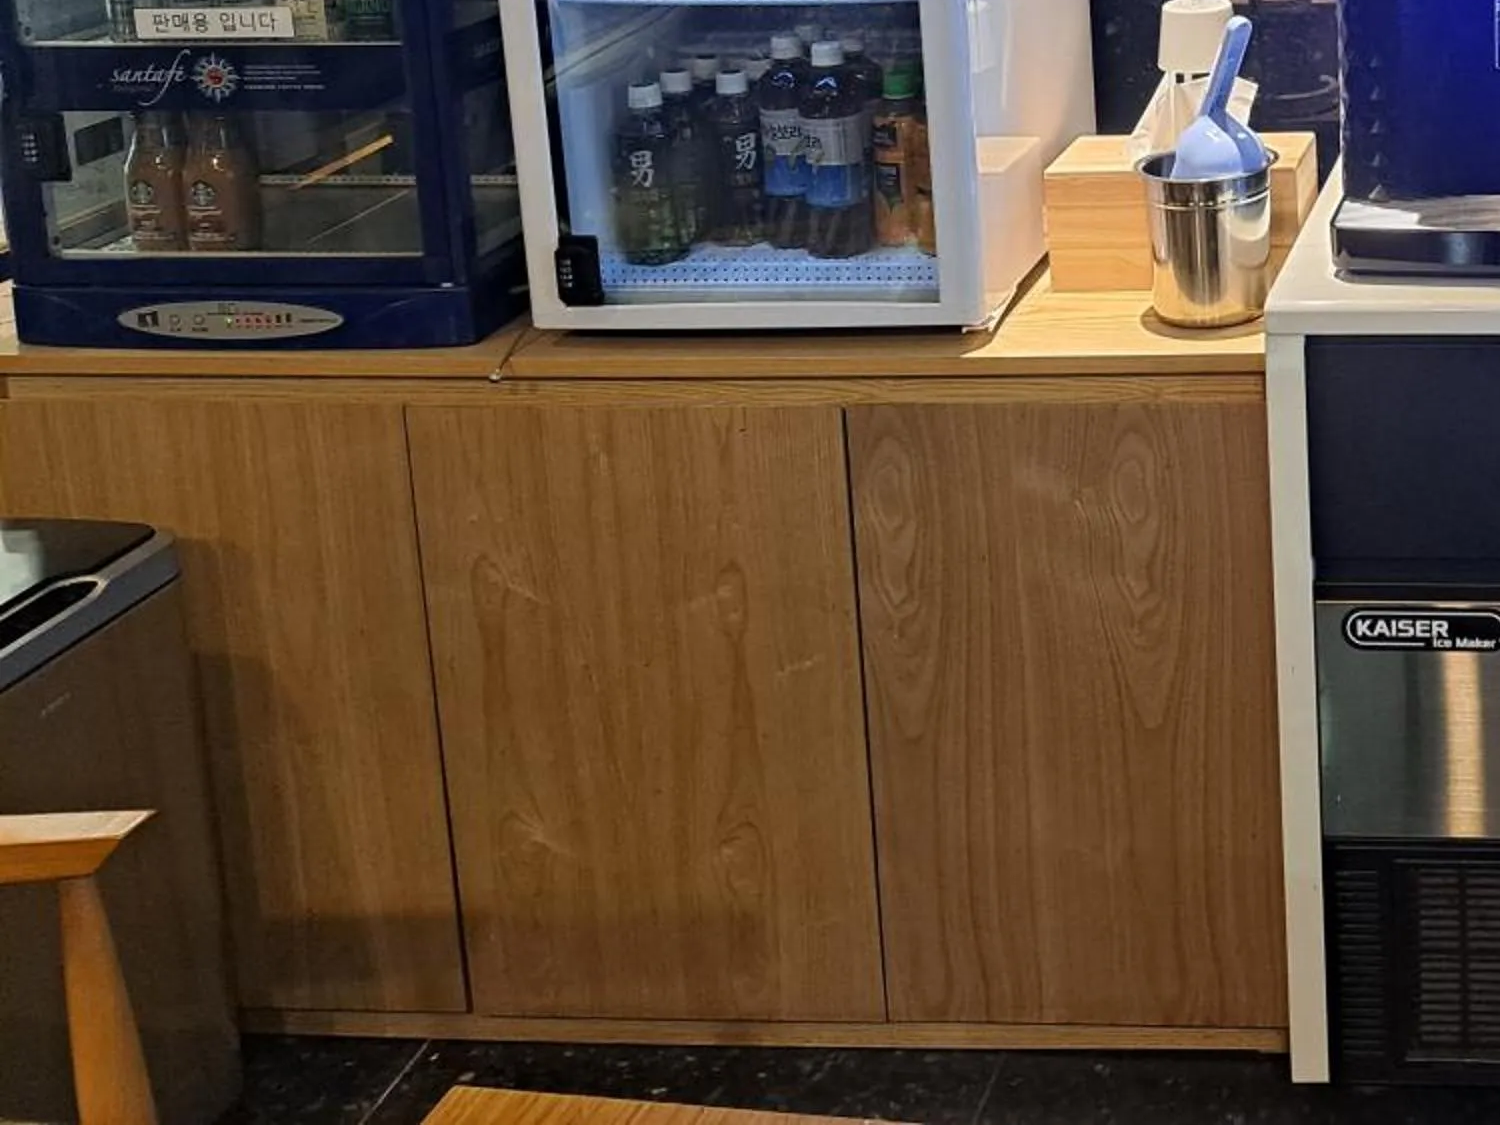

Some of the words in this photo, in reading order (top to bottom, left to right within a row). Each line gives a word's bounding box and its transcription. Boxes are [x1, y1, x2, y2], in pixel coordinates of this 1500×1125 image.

[152, 12, 209, 34] 판매용
[219, 12, 280, 33] 입니다
[736, 132, 757, 170] 男
[629, 149, 655, 188] 男
[1355, 618, 1449, 638] KAISER
[1432, 635, 1453, 648] Ice
[1454, 636, 1497, 650] Maker
